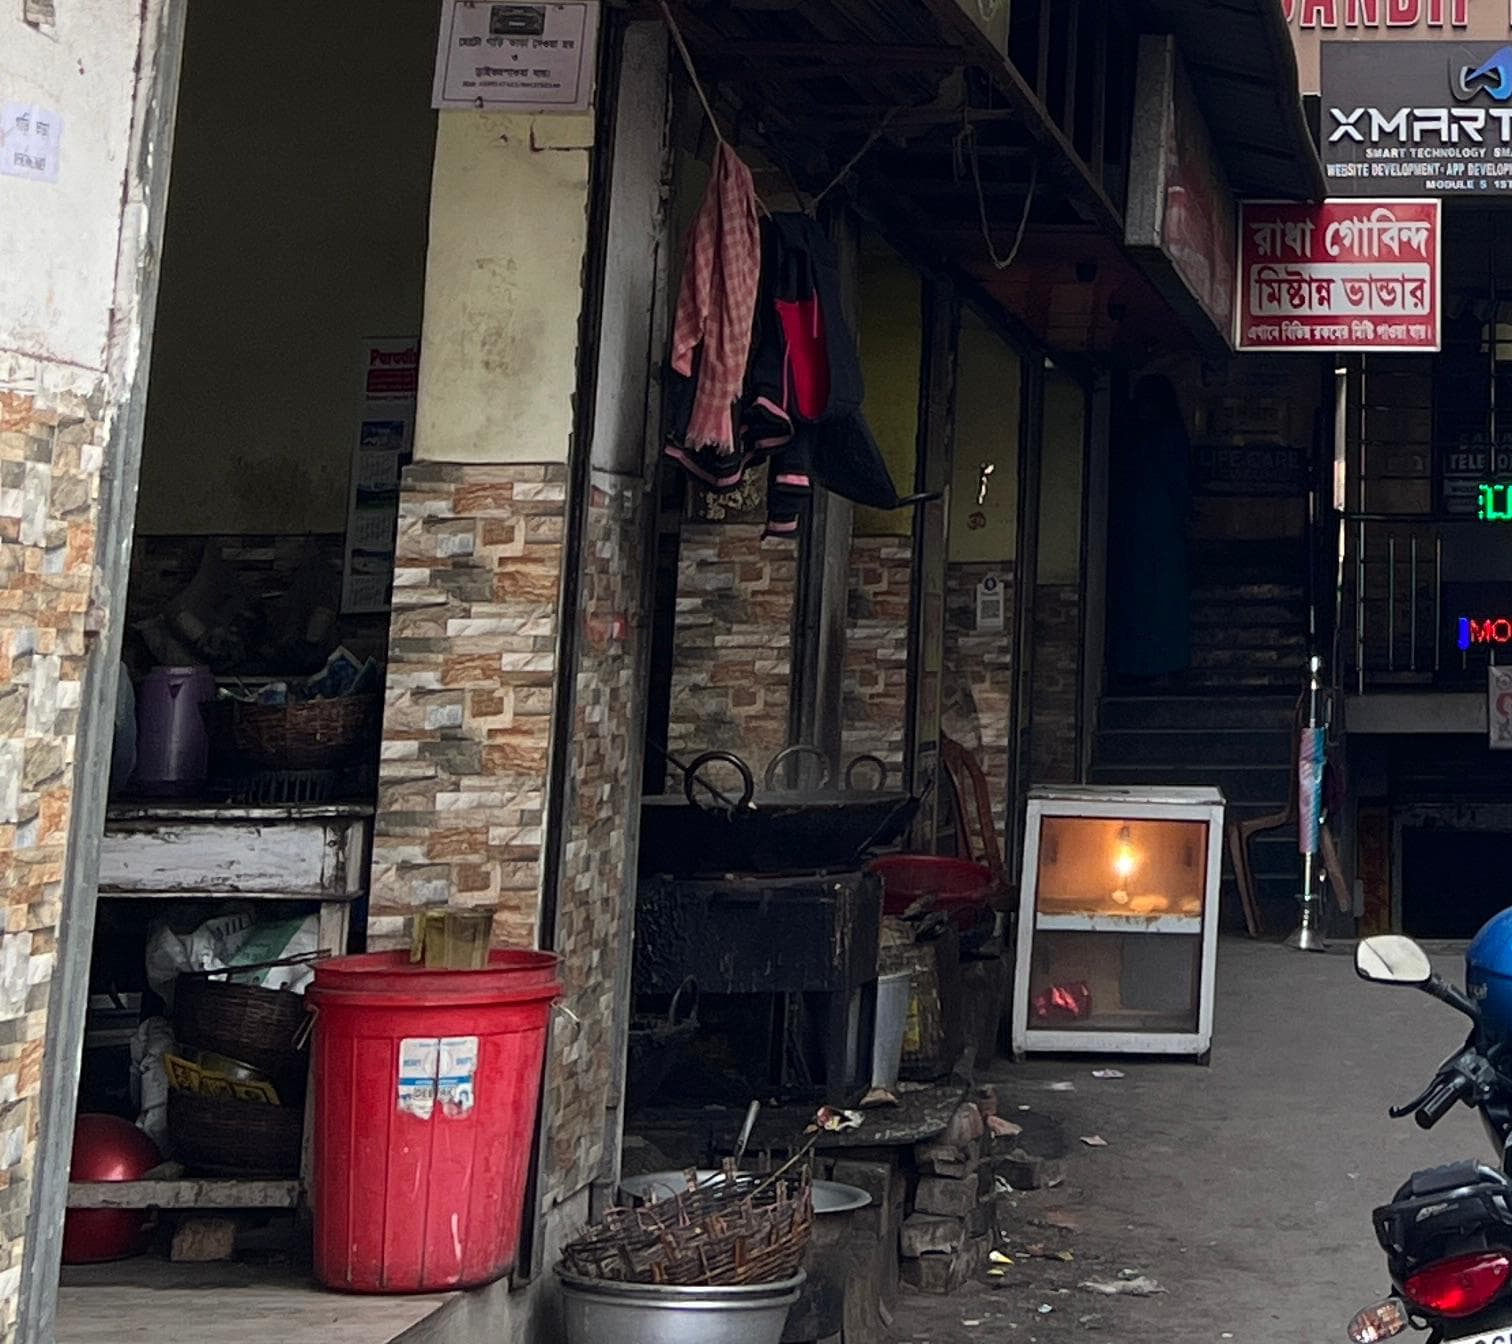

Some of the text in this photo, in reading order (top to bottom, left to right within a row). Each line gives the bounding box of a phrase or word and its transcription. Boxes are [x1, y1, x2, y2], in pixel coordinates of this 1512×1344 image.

[1365, 147, 1406, 159] SMART
[1409, 147, 1487, 159] TECHNOLOGY
[1327, 162, 1370, 178] WEBSITE
[1446, 163, 1467, 178] APP
[1426, 179, 1475, 191] MODULE
[1252, 207, 1432, 259] রাধা গোবিন্দ
